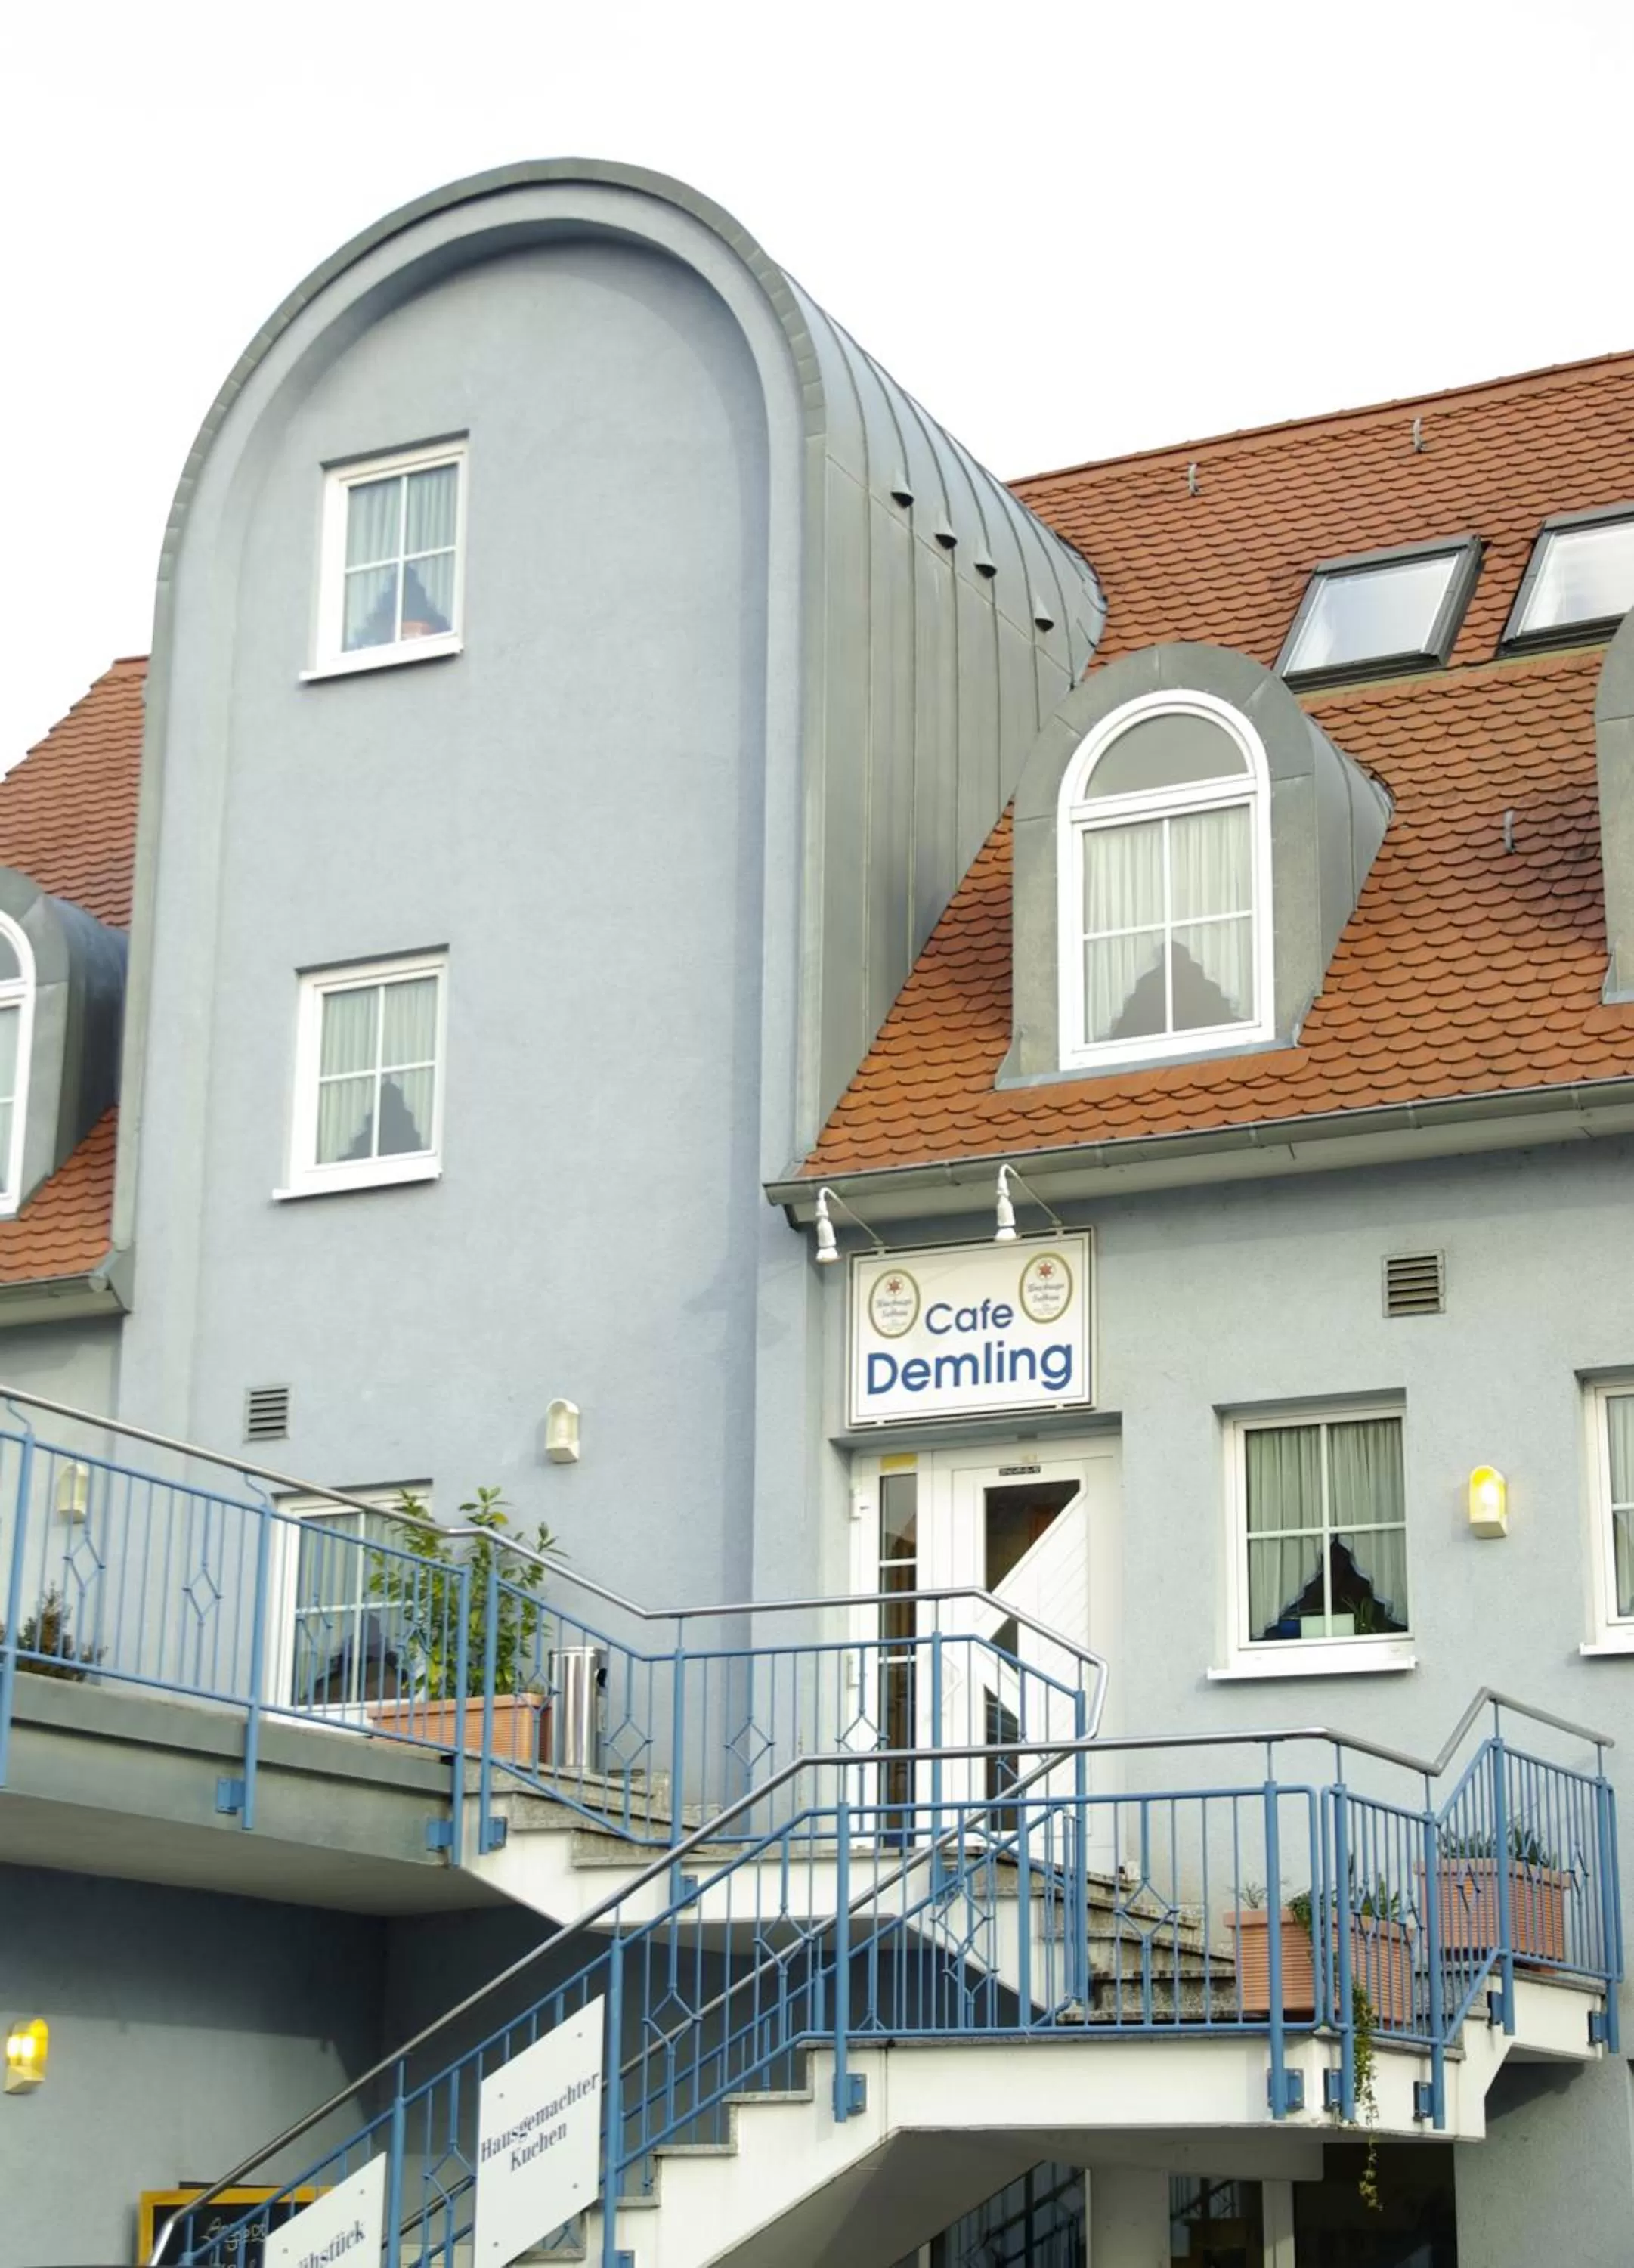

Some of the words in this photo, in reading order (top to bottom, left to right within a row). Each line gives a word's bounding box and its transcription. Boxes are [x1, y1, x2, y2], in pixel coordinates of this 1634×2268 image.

[925, 1298, 1014, 1335] Cafe
[867, 1340, 1072, 1396] Demling
[481, 2072, 599, 2162] Hausgemachter
[510, 2123, 567, 2172] Kuchen
